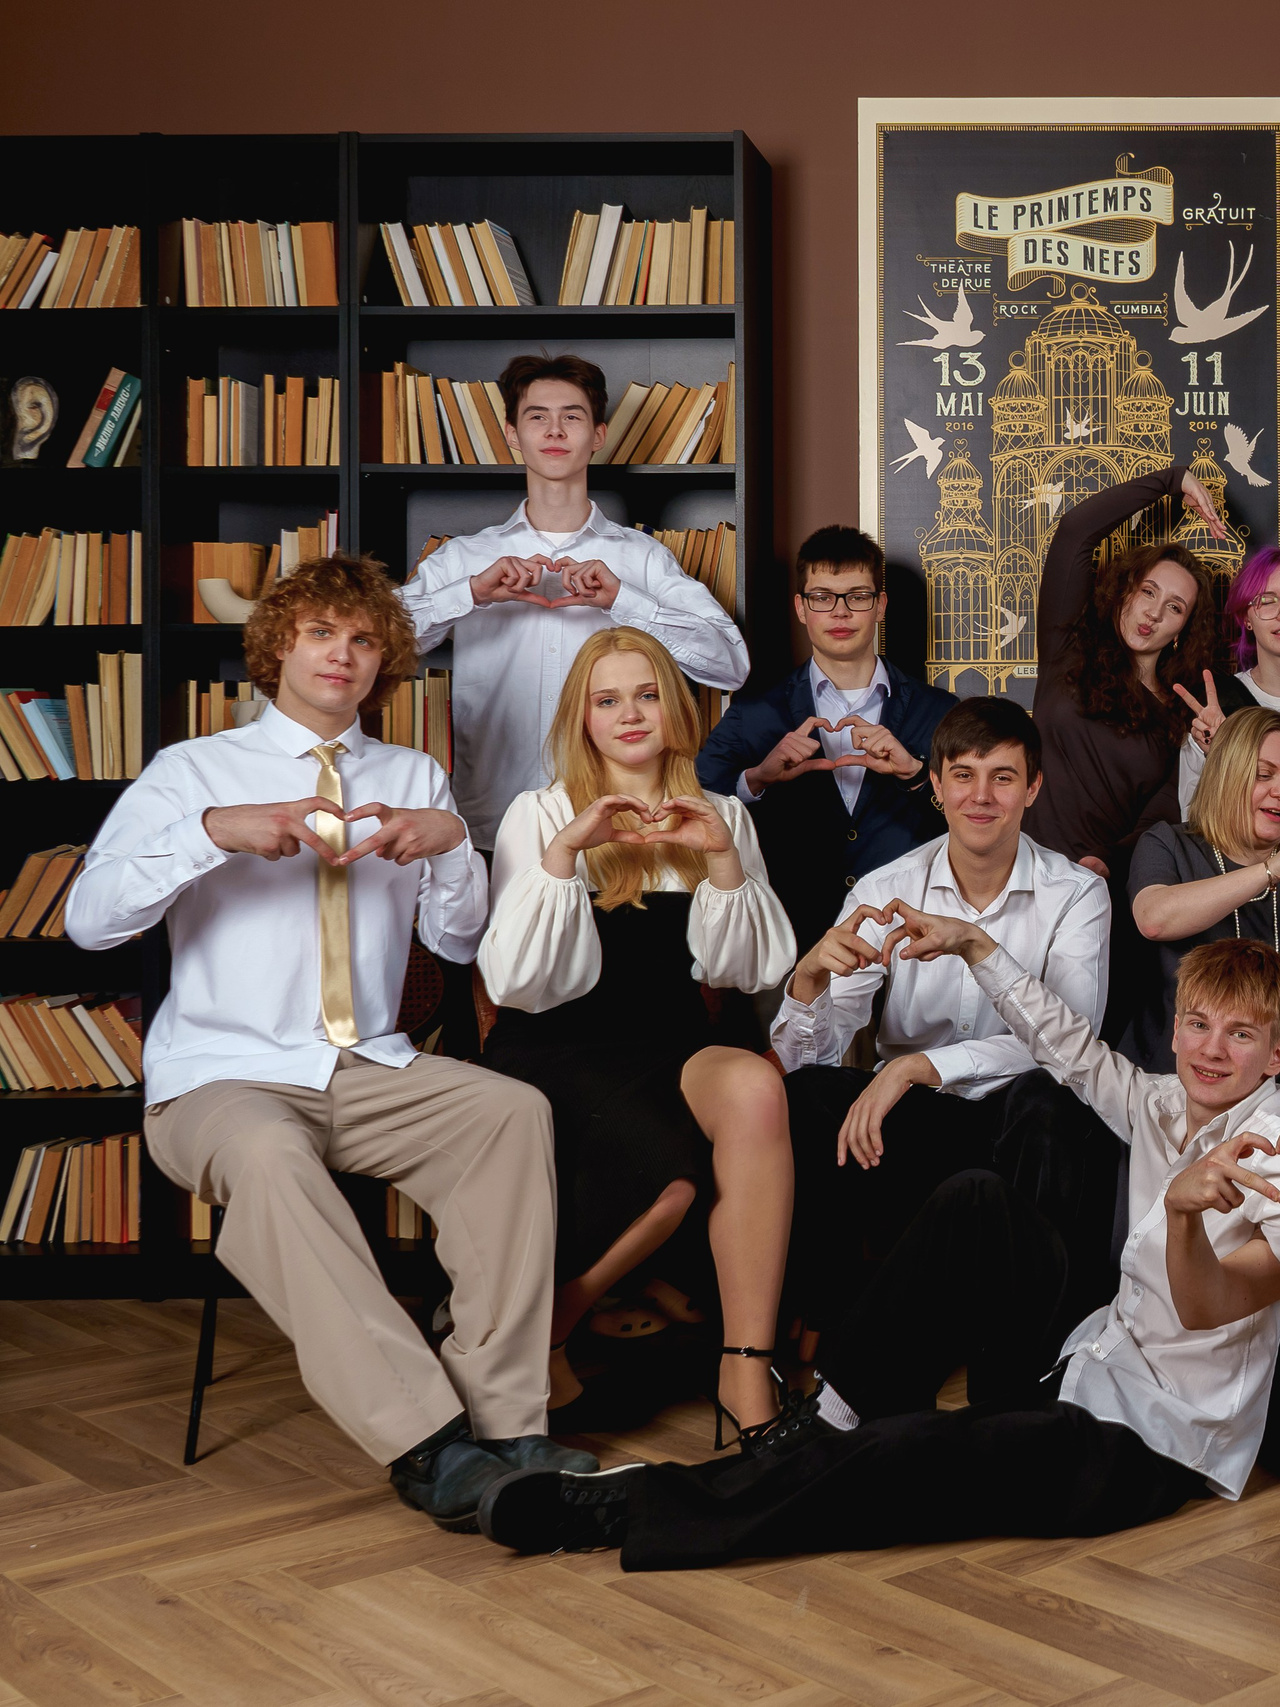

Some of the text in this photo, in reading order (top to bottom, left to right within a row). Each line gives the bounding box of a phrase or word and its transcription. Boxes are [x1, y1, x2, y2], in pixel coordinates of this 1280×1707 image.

[973, 186, 1152, 231] LE PRINTEMPS
[1182, 194, 1255, 224] GRATUIT
[1024, 238, 1141, 276] DES NEFS
[941, 278, 991, 291] DE RUE
[999, 305, 1037, 317] ROCK
[1113, 305, 1162, 315] CUMBIA
[932, 352, 986, 386] 13
[1181, 352, 1224, 386] 11
[111, 388, 130, 421] ЛАЦИС
[936, 392, 983, 416] MAI
[1175, 391, 1230, 416] JUIN
[945, 421, 975, 433] 2016
[1188, 421, 1218, 432] 2016
